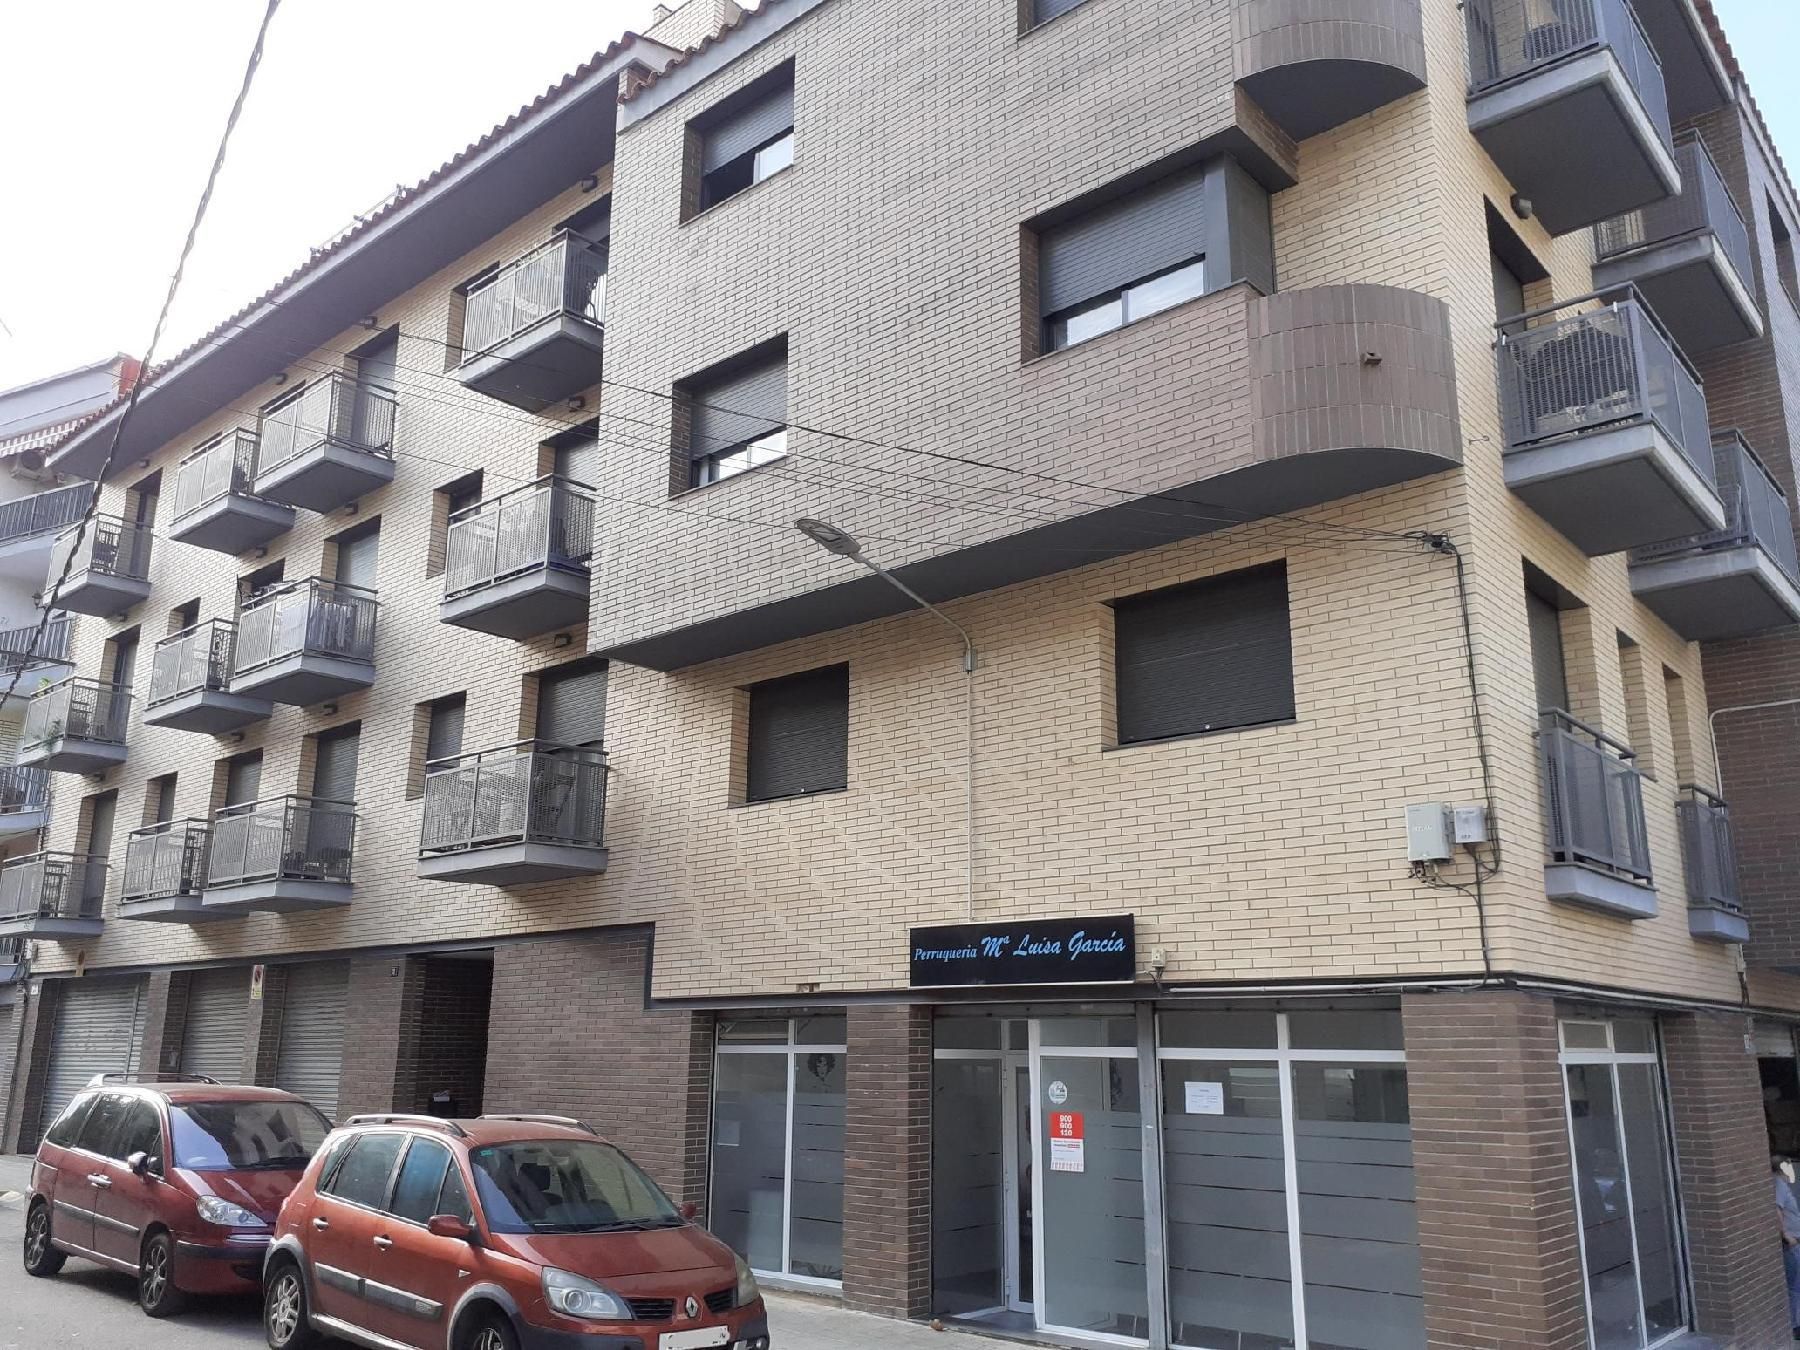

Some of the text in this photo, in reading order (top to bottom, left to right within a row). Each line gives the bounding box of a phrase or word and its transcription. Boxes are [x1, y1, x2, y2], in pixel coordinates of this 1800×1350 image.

[1012, 934, 1061, 956] Luisa
[1067, 930, 1126, 961] García
[1059, 1114, 1073, 1123] 900
